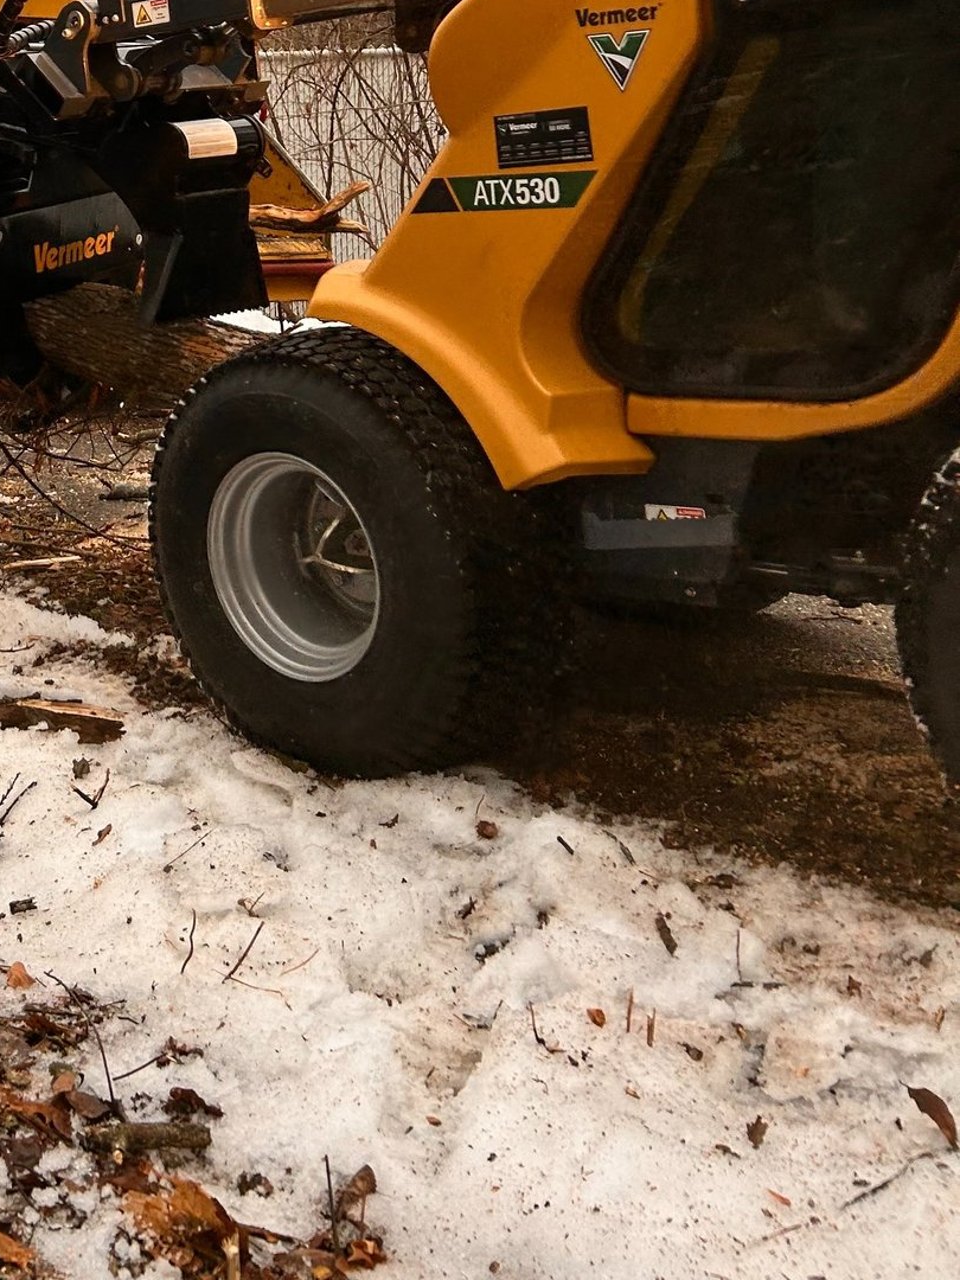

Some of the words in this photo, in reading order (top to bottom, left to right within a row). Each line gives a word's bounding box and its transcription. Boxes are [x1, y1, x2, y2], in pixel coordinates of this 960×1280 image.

[575, 5, 658, 28] Vermeer
[473, 177, 560, 206] ATX530
[33, 231, 115, 273] Vermeer
